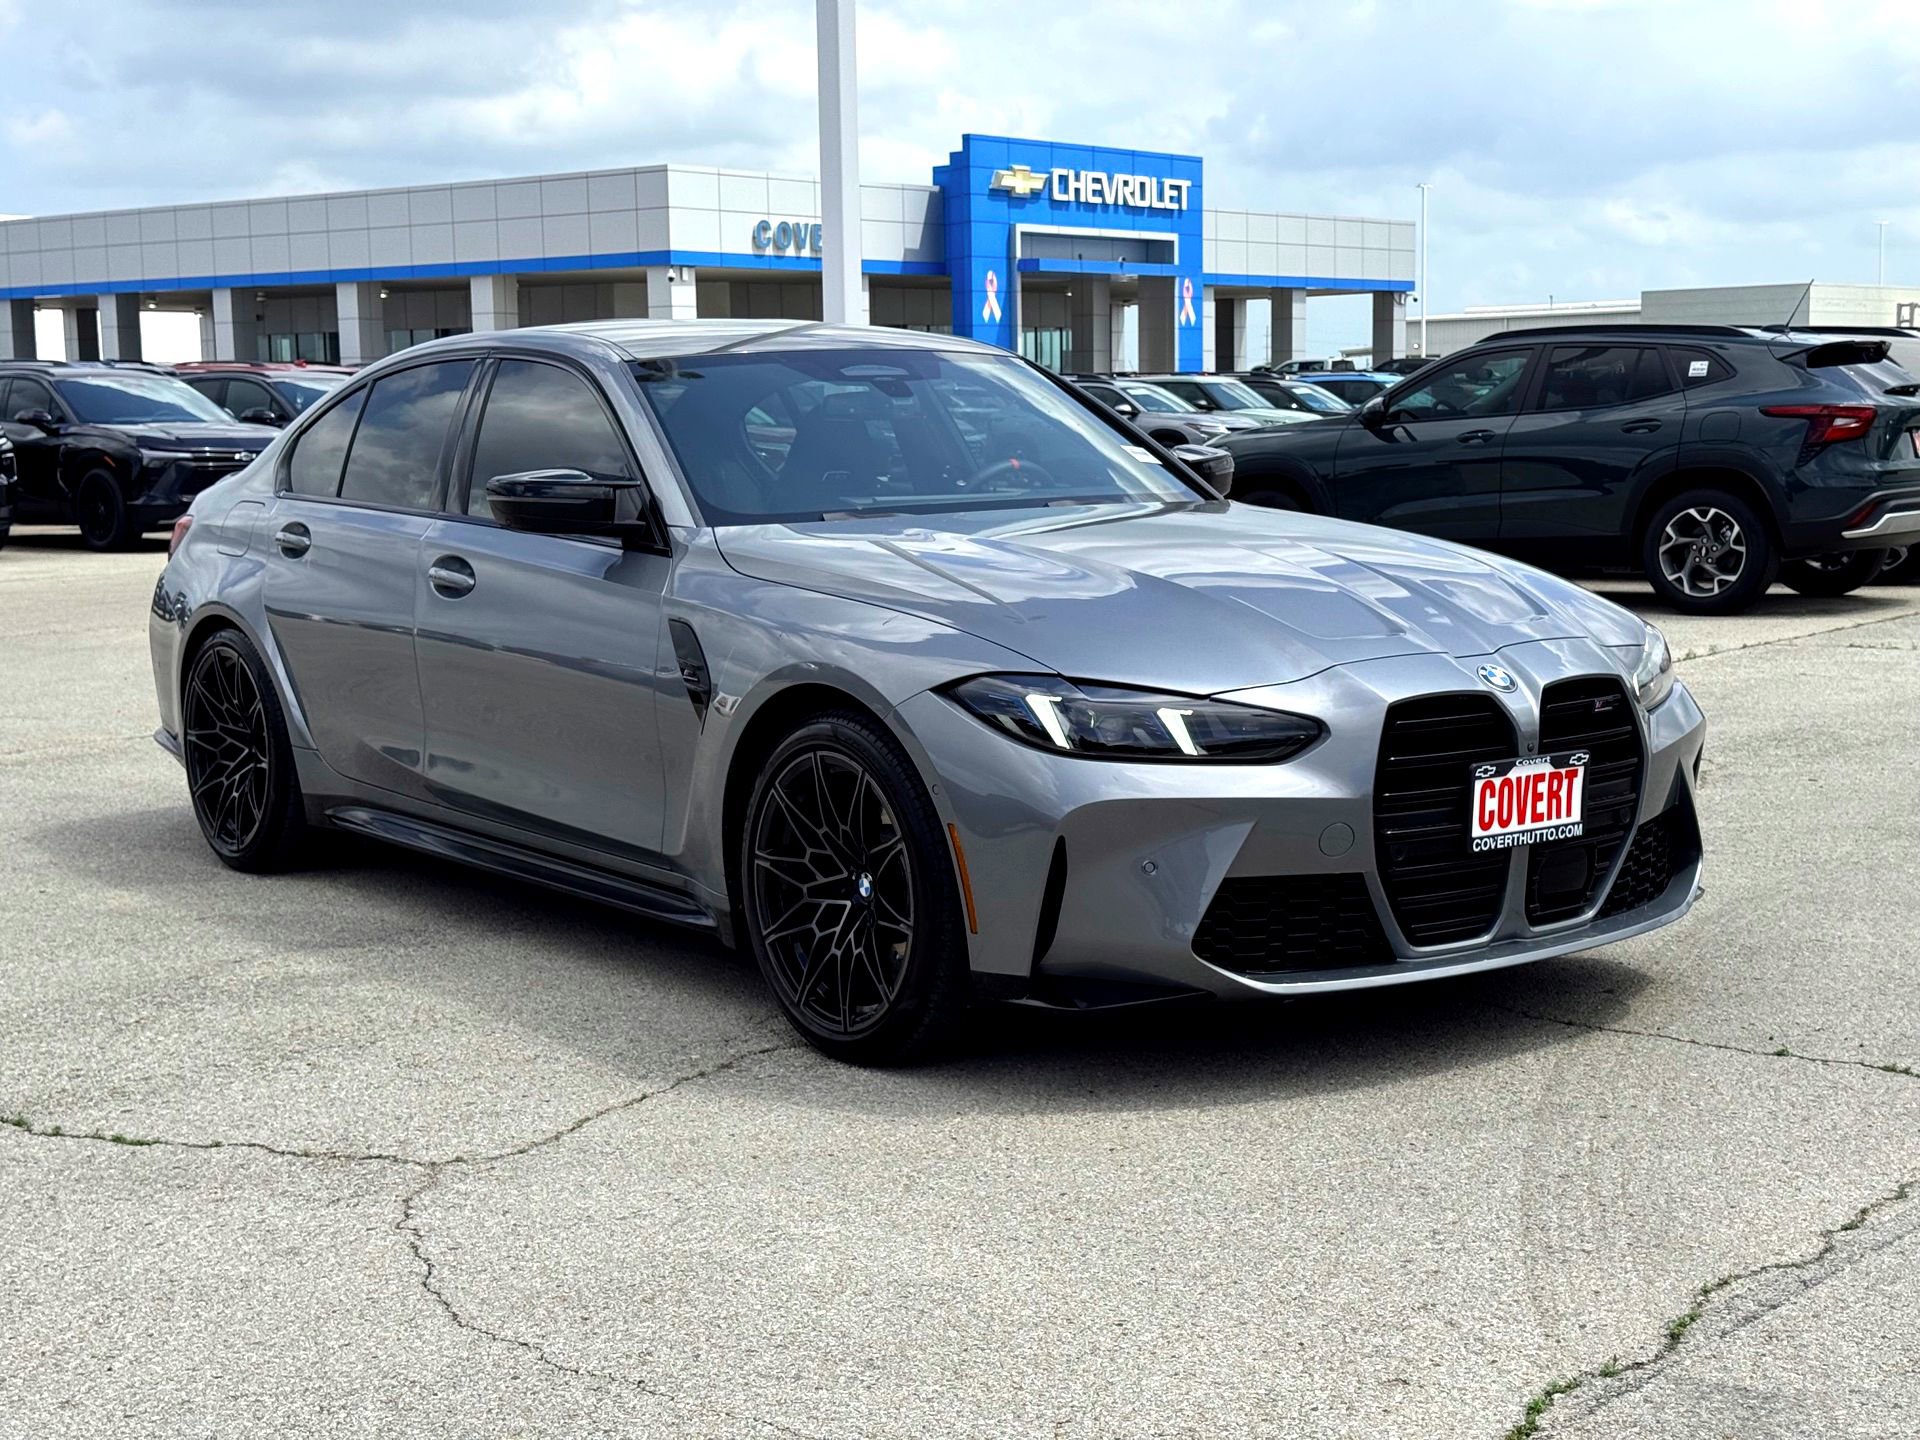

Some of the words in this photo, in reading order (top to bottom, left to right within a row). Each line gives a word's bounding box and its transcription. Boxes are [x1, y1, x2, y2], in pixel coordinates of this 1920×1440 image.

[1051, 167, 1192, 211] CHEVROLET
[1515, 756, 1551, 767] Covert
[1478, 768, 1579, 831] COVERT
[1472, 823, 1583, 853] COVERTHUTTO.COM
